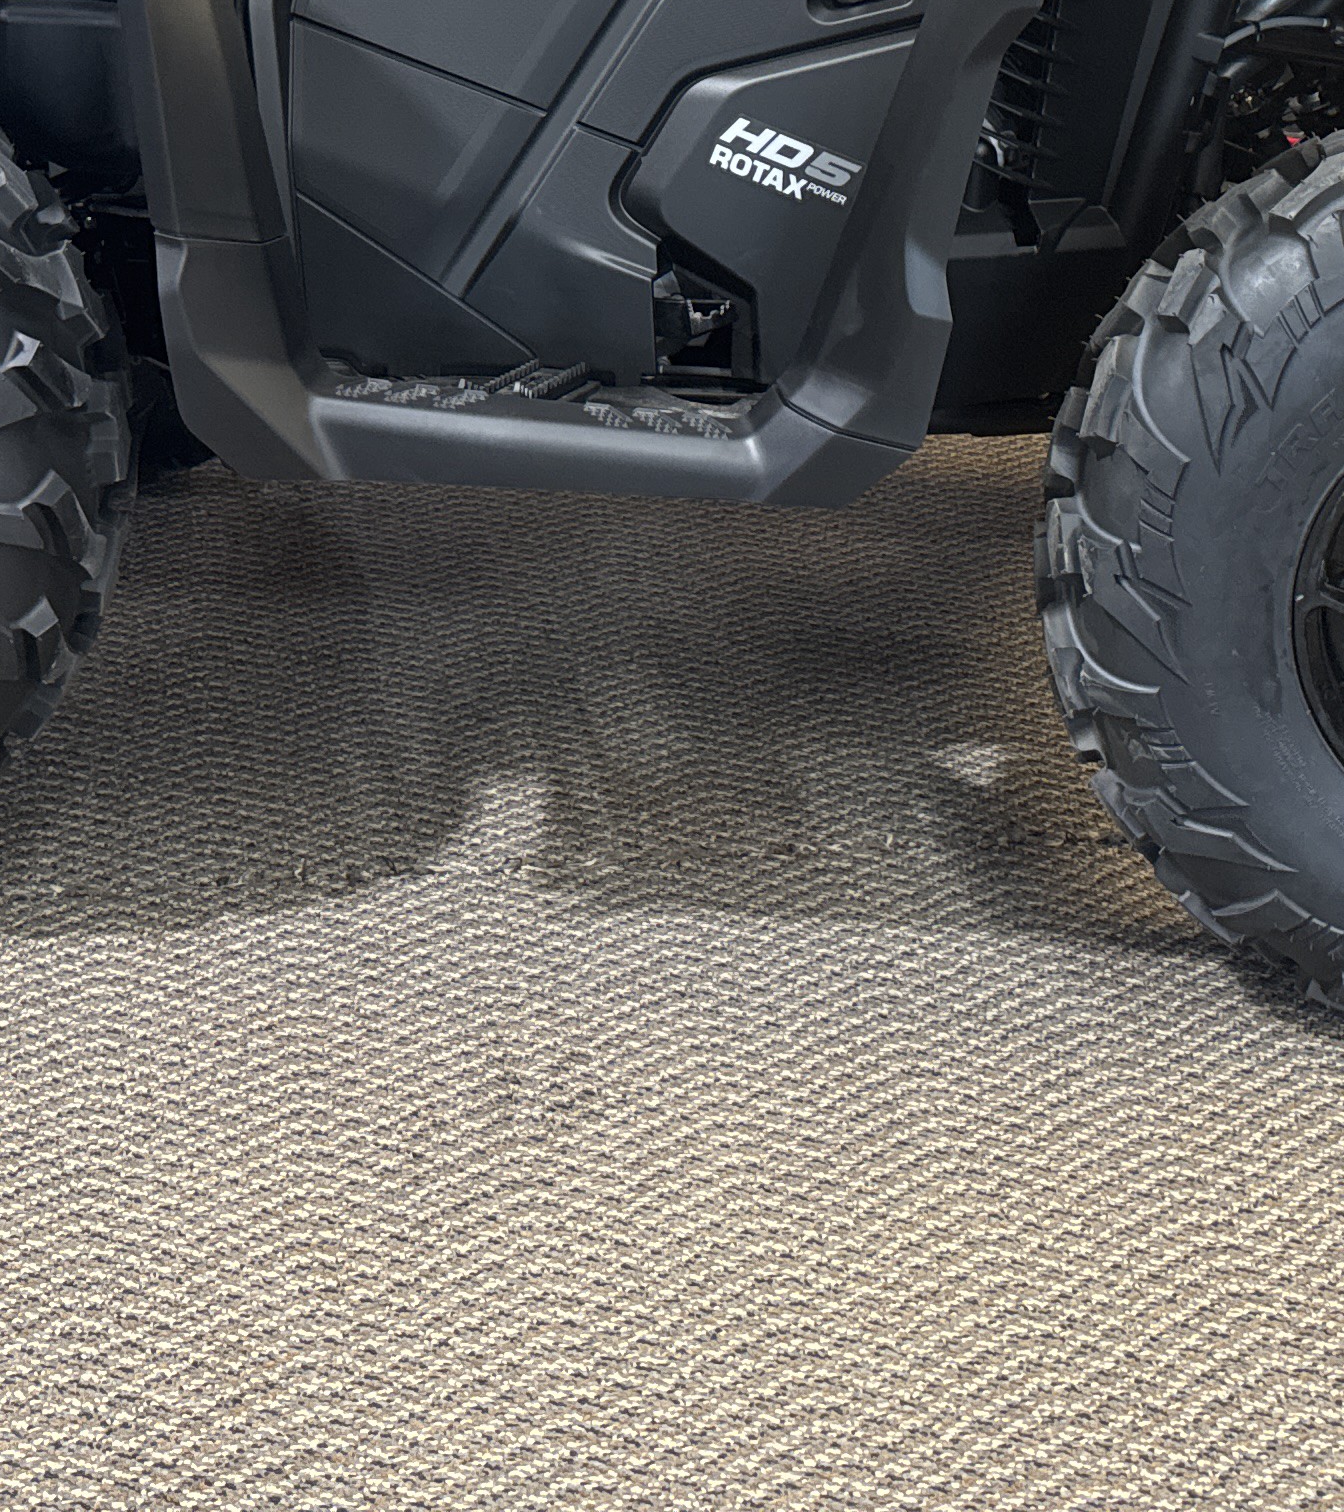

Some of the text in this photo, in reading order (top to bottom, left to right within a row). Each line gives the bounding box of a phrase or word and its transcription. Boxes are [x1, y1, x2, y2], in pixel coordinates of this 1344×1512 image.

[709, 143, 848, 207] ROTAX POWER
[718, 117, 863, 188] HD5
